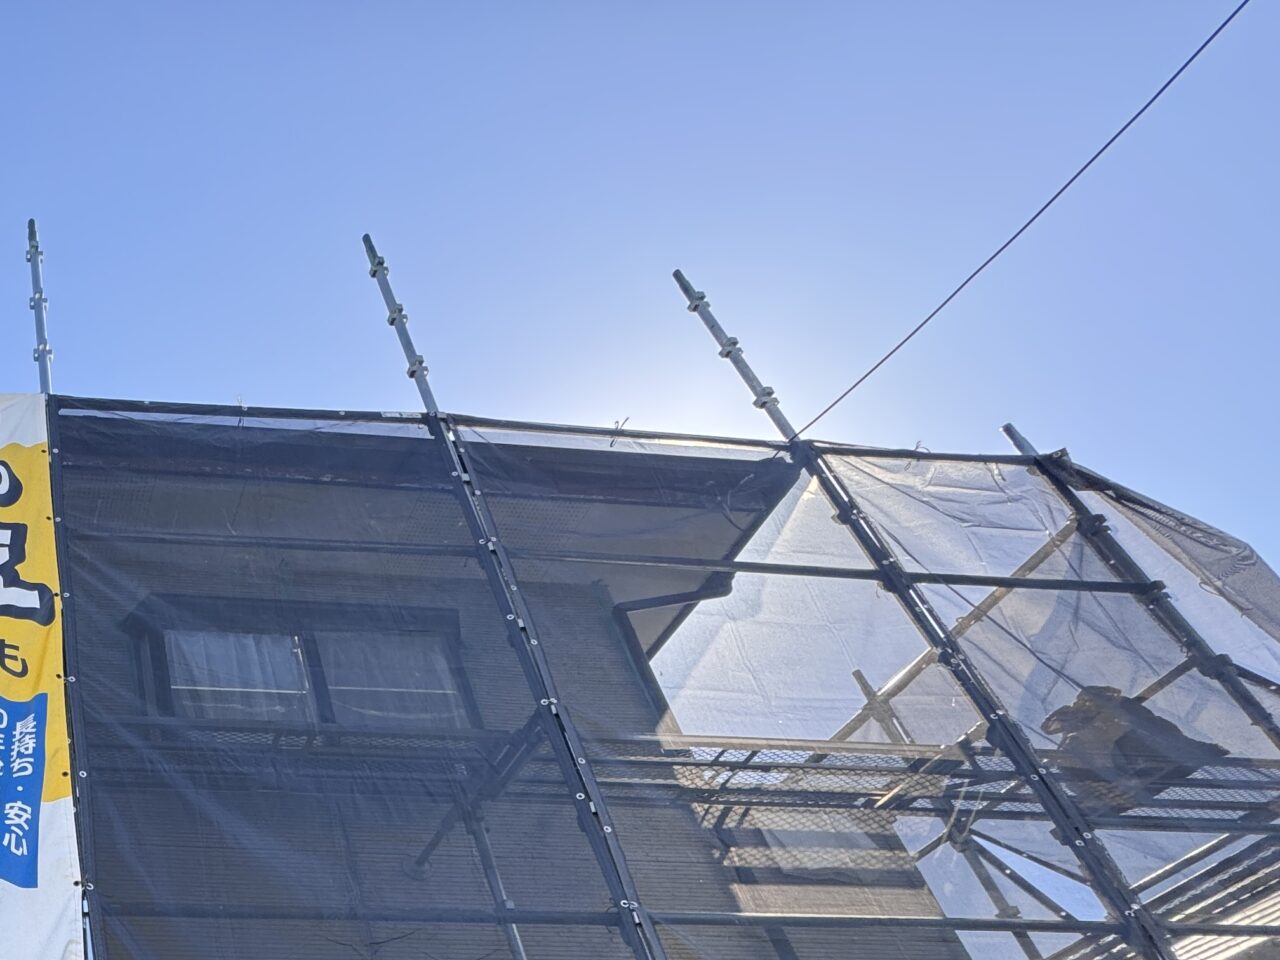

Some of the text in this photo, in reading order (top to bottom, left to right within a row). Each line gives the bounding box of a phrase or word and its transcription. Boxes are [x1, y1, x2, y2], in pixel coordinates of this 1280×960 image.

[2, 713, 36, 856] 長持ち・安心
